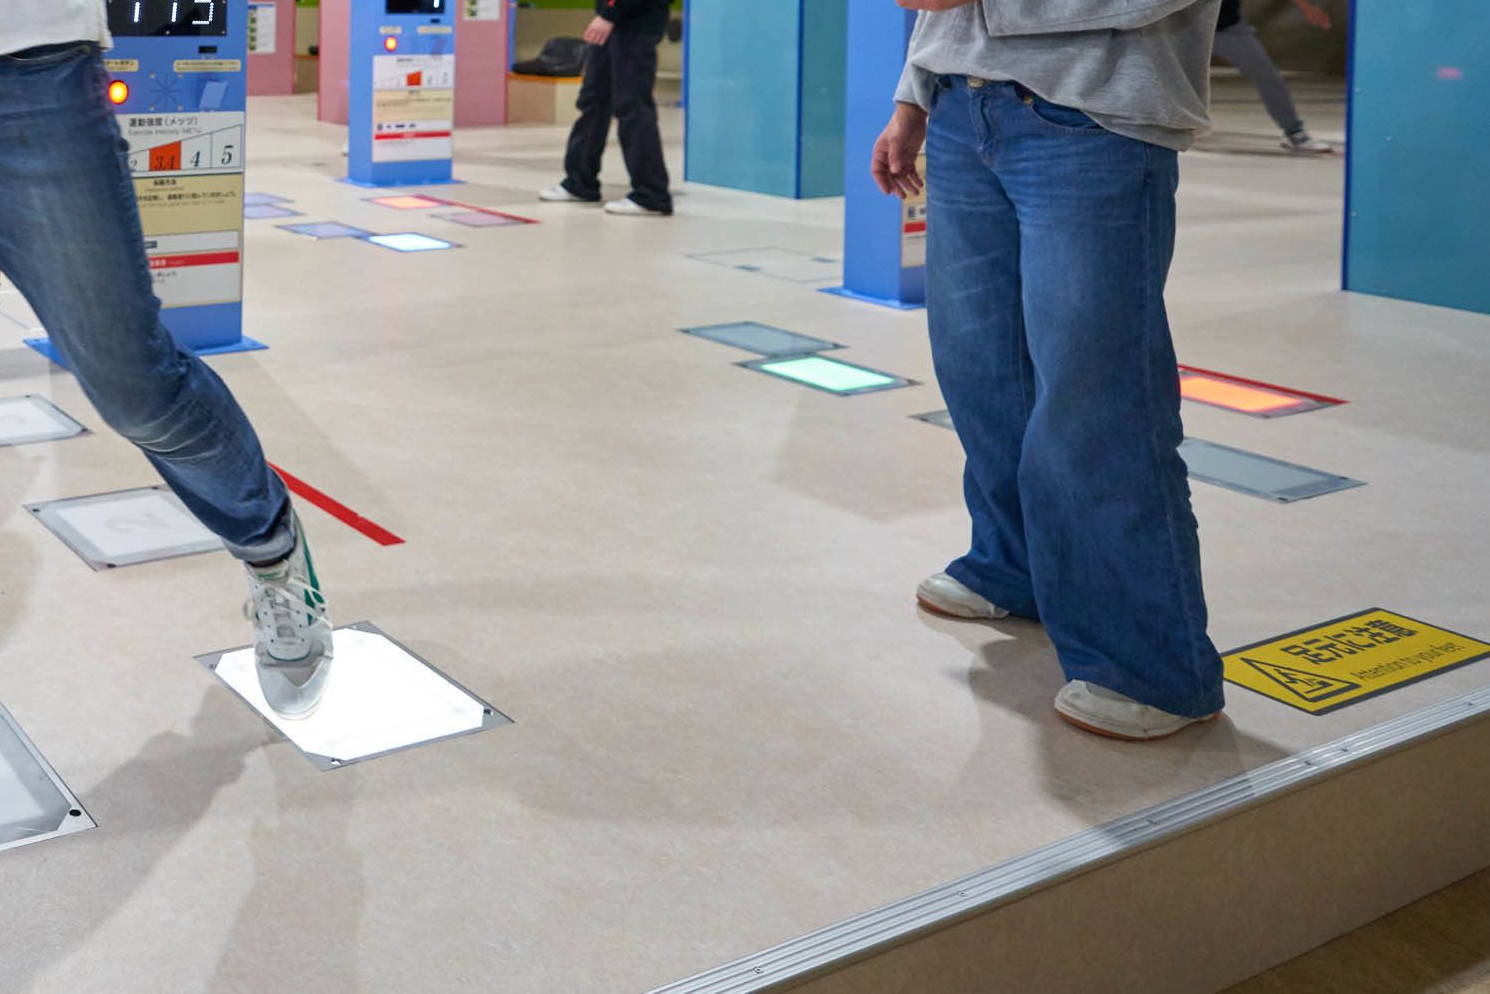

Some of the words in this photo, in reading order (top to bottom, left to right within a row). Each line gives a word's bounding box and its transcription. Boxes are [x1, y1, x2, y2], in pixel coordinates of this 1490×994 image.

[190, 150, 201, 167] 4
[221, 144, 234, 165] 5
[1280, 619, 1417, 665] 足元に注意
